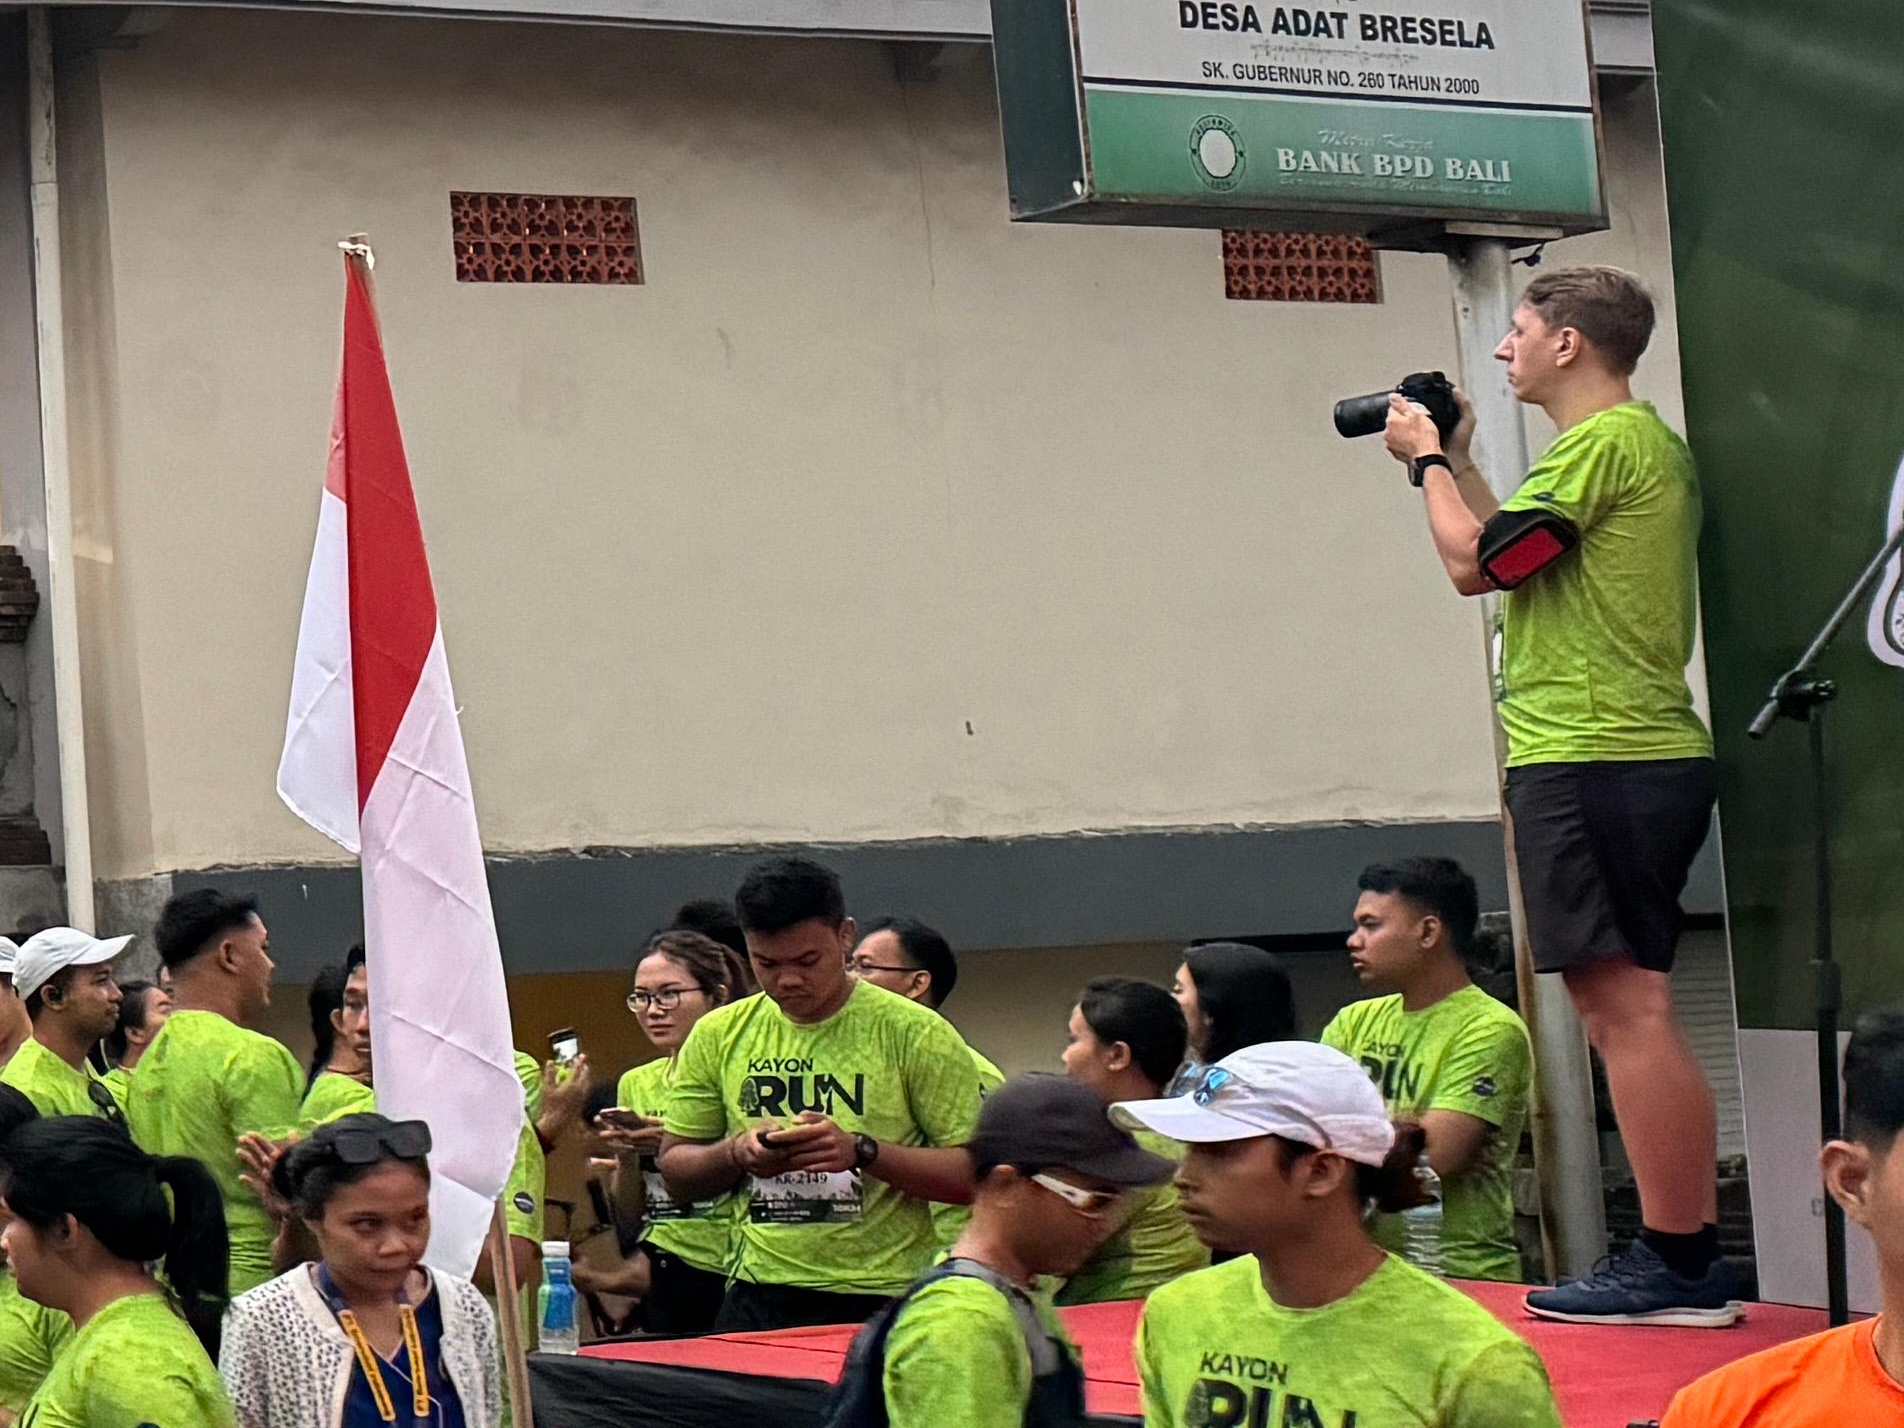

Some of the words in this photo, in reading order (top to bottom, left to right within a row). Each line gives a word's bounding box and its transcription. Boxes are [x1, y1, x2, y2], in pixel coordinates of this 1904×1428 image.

[1178, 0, 1262, 34] DESA
[1271, 6, 1348, 39] ADAT
[1359, 13, 1495, 50] BRESELA
[1201, 61, 1229, 79] SK.
[1232, 63, 1324, 85] GUBERNUR
[1327, 69, 1354, 87] NO.
[1387, 73, 1442, 93] TAHUN
[1444, 77, 1480, 95] 2000
[1276, 147, 1363, 176] BANK
[1373, 152, 1434, 179] BPD
[1445, 158, 1513, 183] BALI
[748, 1058, 814, 1074] KAYON
[739, 1073, 865, 1118] RUN
[1199, 1350, 1288, 1387] KAYON
